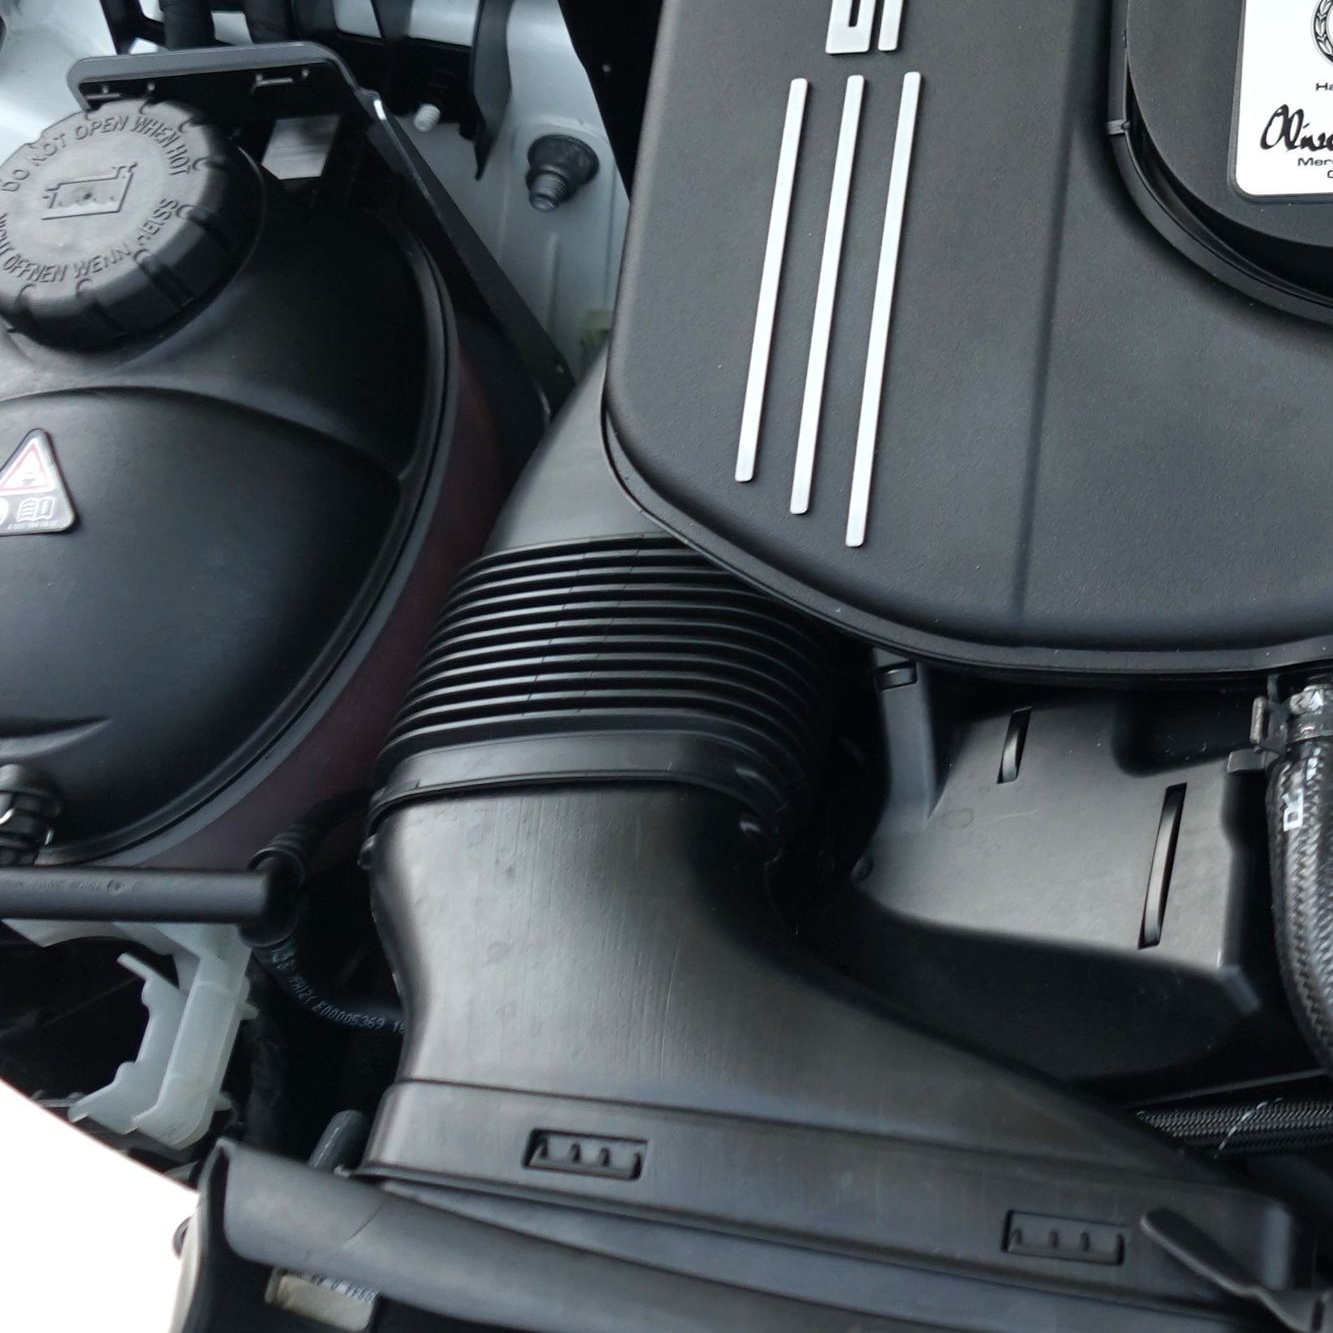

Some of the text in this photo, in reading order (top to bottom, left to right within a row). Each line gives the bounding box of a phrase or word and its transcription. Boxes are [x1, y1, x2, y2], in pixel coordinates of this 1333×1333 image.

[31, 133, 67, 167] NOT
[74, 115, 129, 141] OPEN
[130, 115, 180, 150] WHEN
[166, 143, 191, 177] HOT
[73, 242, 132, 279] WENN
[136, 197, 179, 247] HEISS
